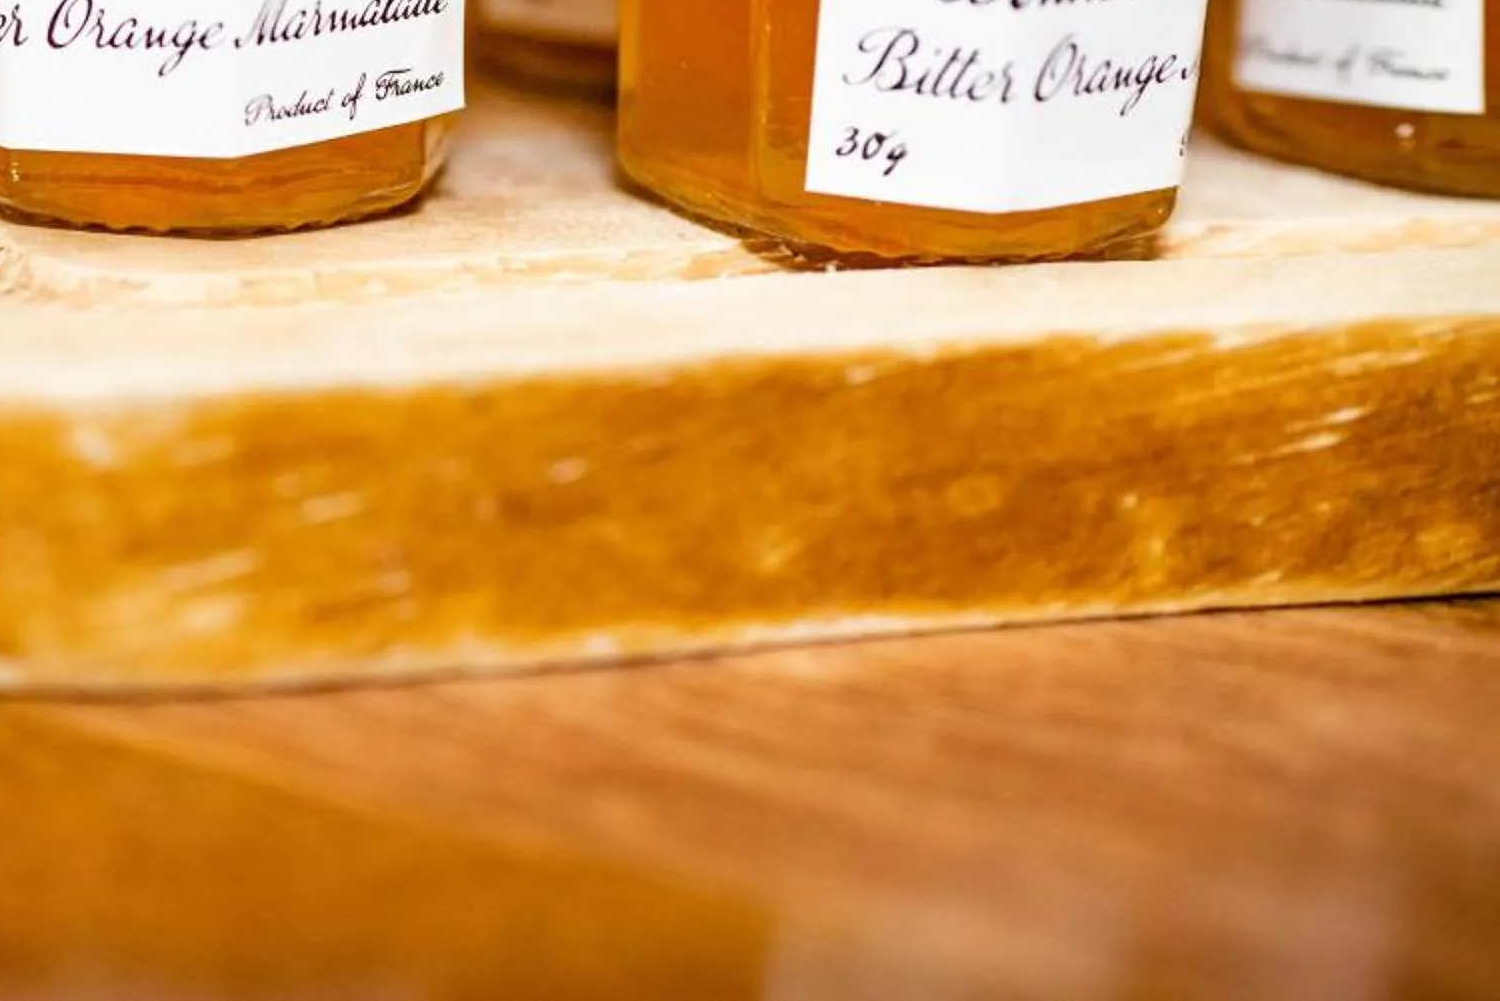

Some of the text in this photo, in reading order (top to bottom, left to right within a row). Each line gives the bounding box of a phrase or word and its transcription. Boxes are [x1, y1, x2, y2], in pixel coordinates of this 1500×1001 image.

[244, 67, 445, 127] Product of France
[841, 27, 1014, 105] Bitter
[1033, 33, 1178, 117] Orange
[835, 126, 909, 178] 30g
